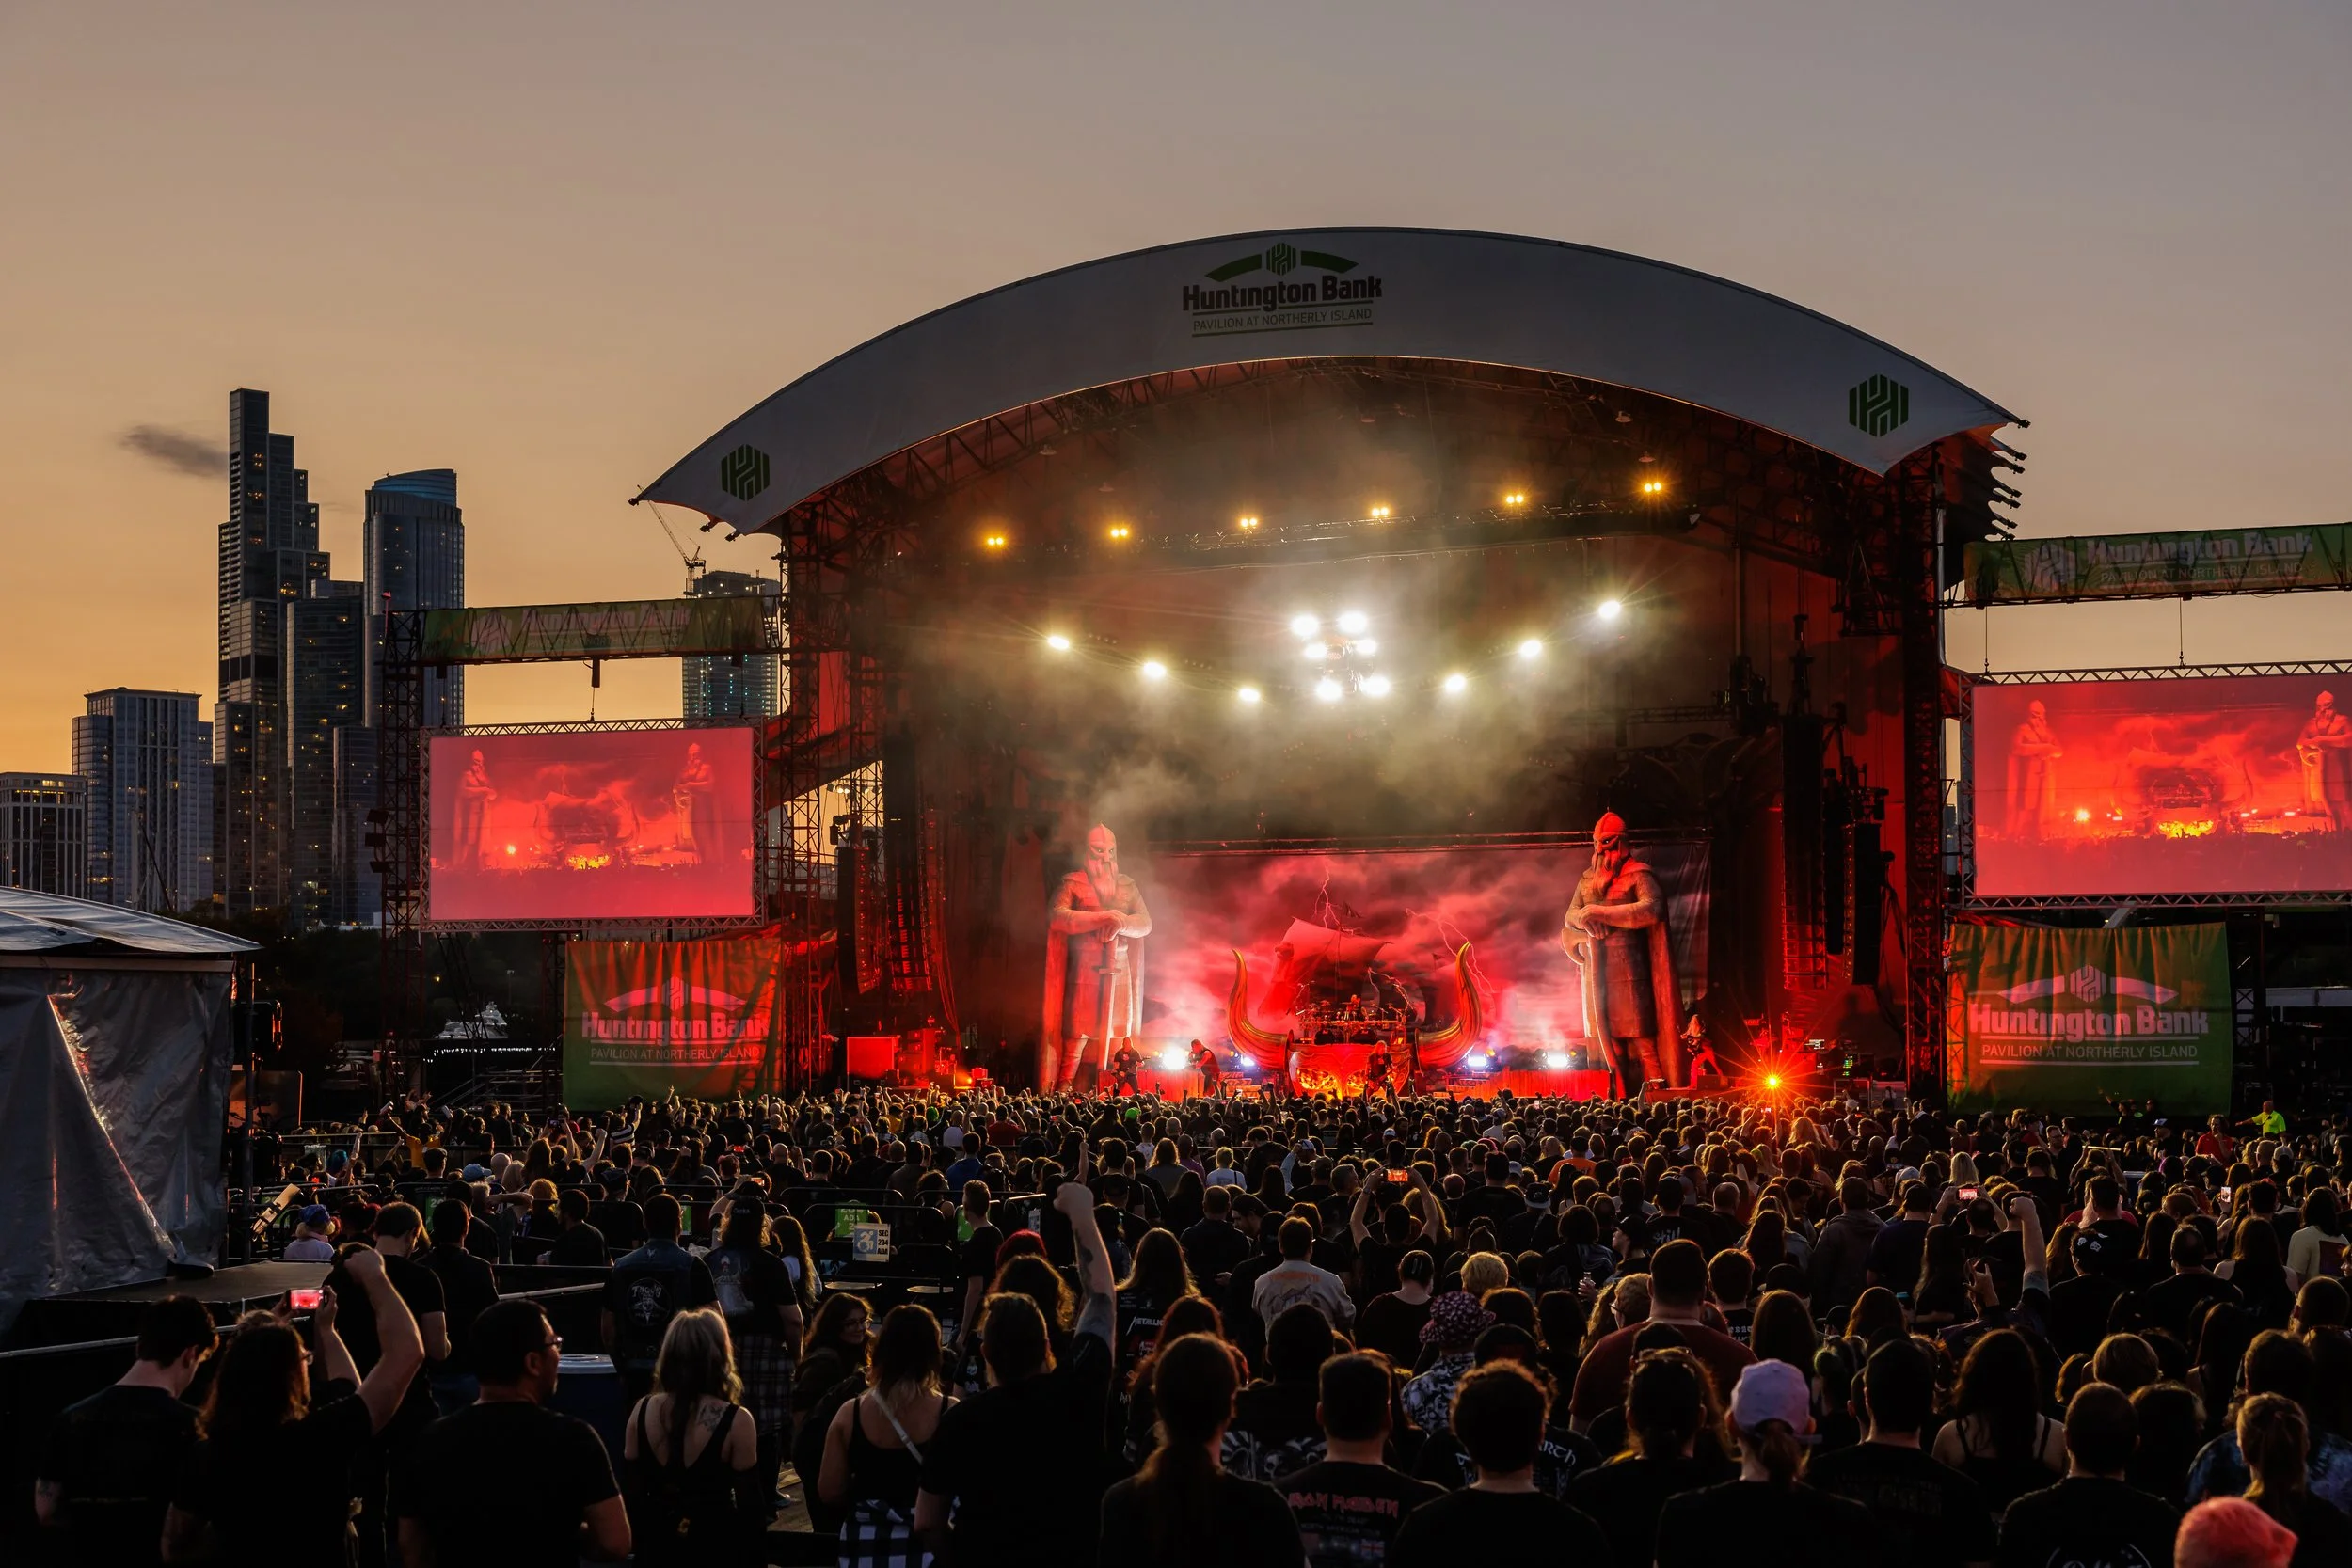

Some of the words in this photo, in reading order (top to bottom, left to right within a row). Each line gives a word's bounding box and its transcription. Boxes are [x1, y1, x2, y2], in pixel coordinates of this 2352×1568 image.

[1182, 281, 1315, 311] Huntington
[1322, 275, 1382, 300] Bank
[1193, 316, 1244, 332] PAVILION
[1247, 315, 1260, 326] AT
[1262, 310, 1328, 325] NORTHERLY
[1330, 308, 1372, 322] ISLAND
[581, 1011, 707, 1046] Huntington
[710, 1011, 769, 1039] Bank
[1969, 1003, 2132, 1043] Huntington
[2136, 1004, 2209, 1035] Bank
[591, 1047, 637, 1060] PAVILION
[640, 1048, 653, 1060] AT
[656, 1046, 717, 1060] NORTHERLY
[719, 1046, 760, 1059] ISLAND
[1981, 1043, 2042, 1058] PAVILION
[2045, 1045, 2061, 1057] AT
[2065, 1045, 2145, 1060] NORTHERLY
[2149, 1044, 2198, 1058] ISLAND
[1126, 1315, 1165, 1336] METALLIC
